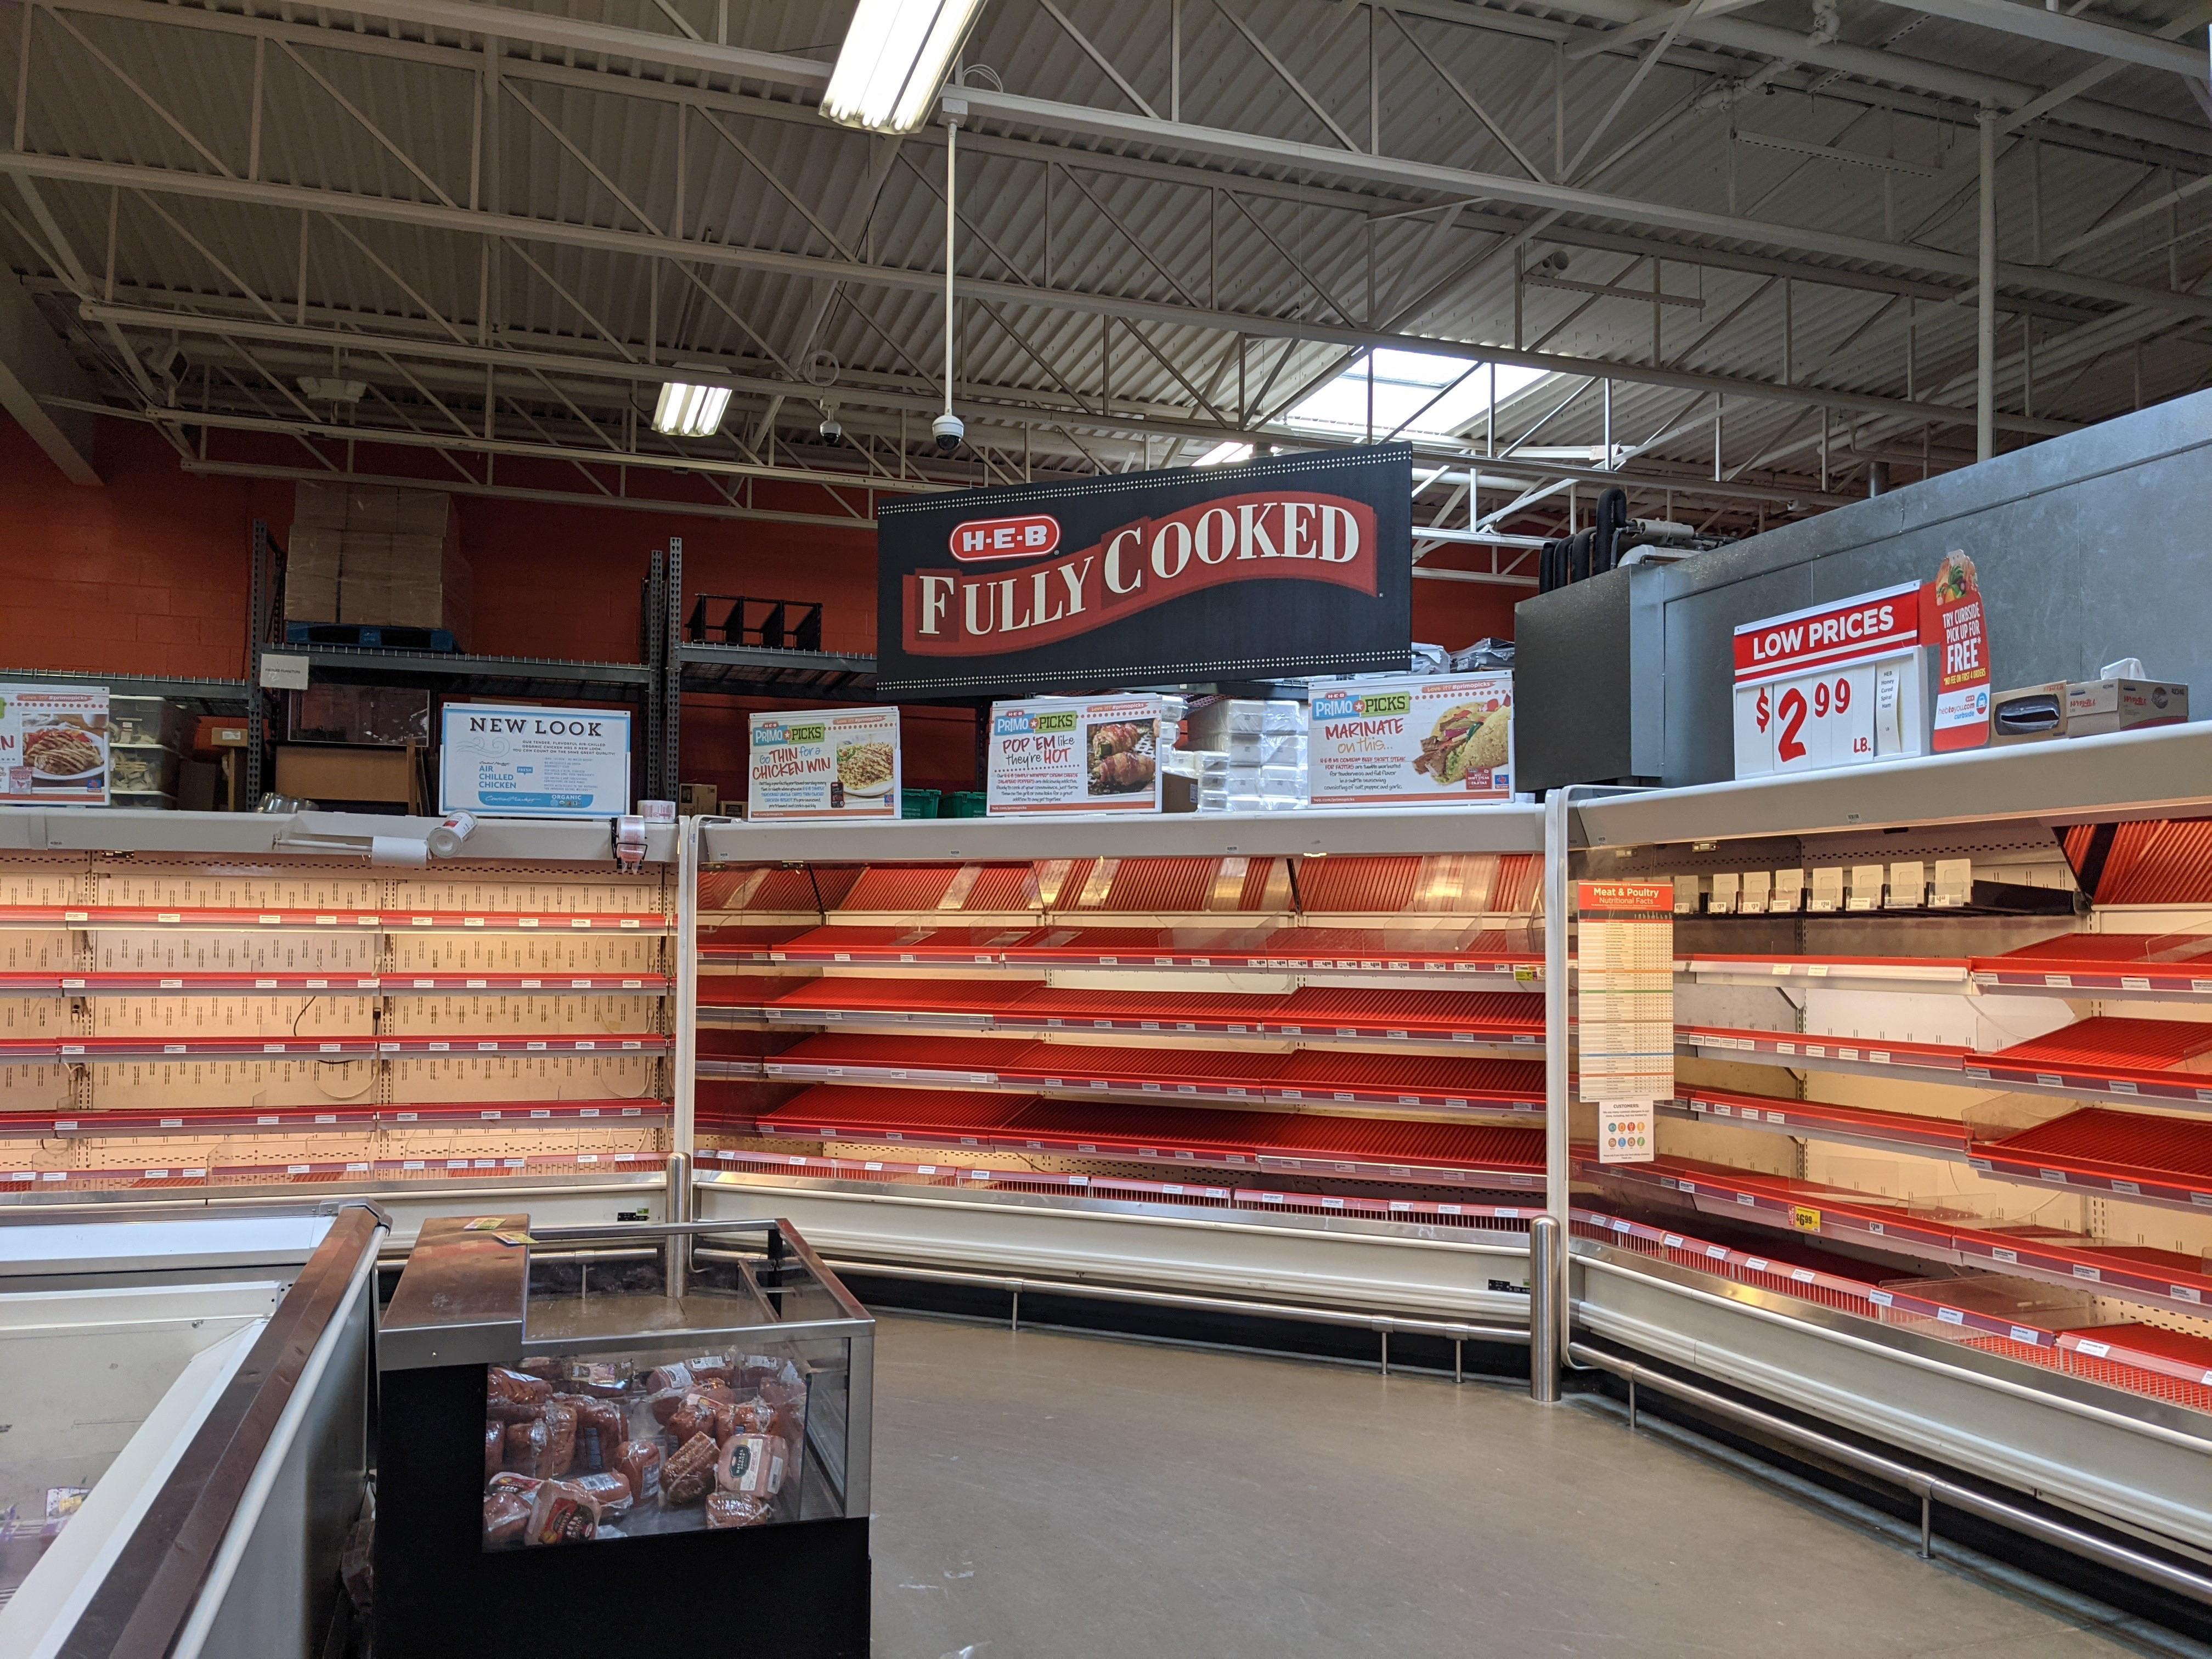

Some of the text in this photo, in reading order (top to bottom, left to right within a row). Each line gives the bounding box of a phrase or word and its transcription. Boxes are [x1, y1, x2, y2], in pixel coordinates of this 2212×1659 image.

[918, 502, 1359, 635] FULLY COOKED
[1943, 602, 1980, 629] TRY CURBSIDE
[1753, 606, 1894, 660] LOW PRICES
[1946, 620, 1980, 644] PICK UP FOR
[1973, 668, 1986, 679] ORDERS
[1452, 681, 1490, 690] #primopicks
[1365, 696, 1406, 713] PICKS
[1938, 702, 1975, 714] hebtoyou.com
[1039, 714, 1073, 729] PICKS
[1954, 710, 1975, 720] curbside
[470, 717, 602, 737] NEW LOOK
[792, 726, 822, 741] PICKS
[1325, 718, 1404, 741] MARINATE
[1002, 735, 1075, 754] POP 'EM like
[1338, 743, 1355, 754] on
[1854, 737, 1871, 753] LB.
[760, 755, 771, 764] Go
[769, 747, 798, 763] THIN
[799, 746, 813, 758] for
[1006, 748, 1071, 768] they're HOT
[752, 757, 831, 780] CHICKEN WIN
[1593, 887, 1659, 898] Meat & Poultry
